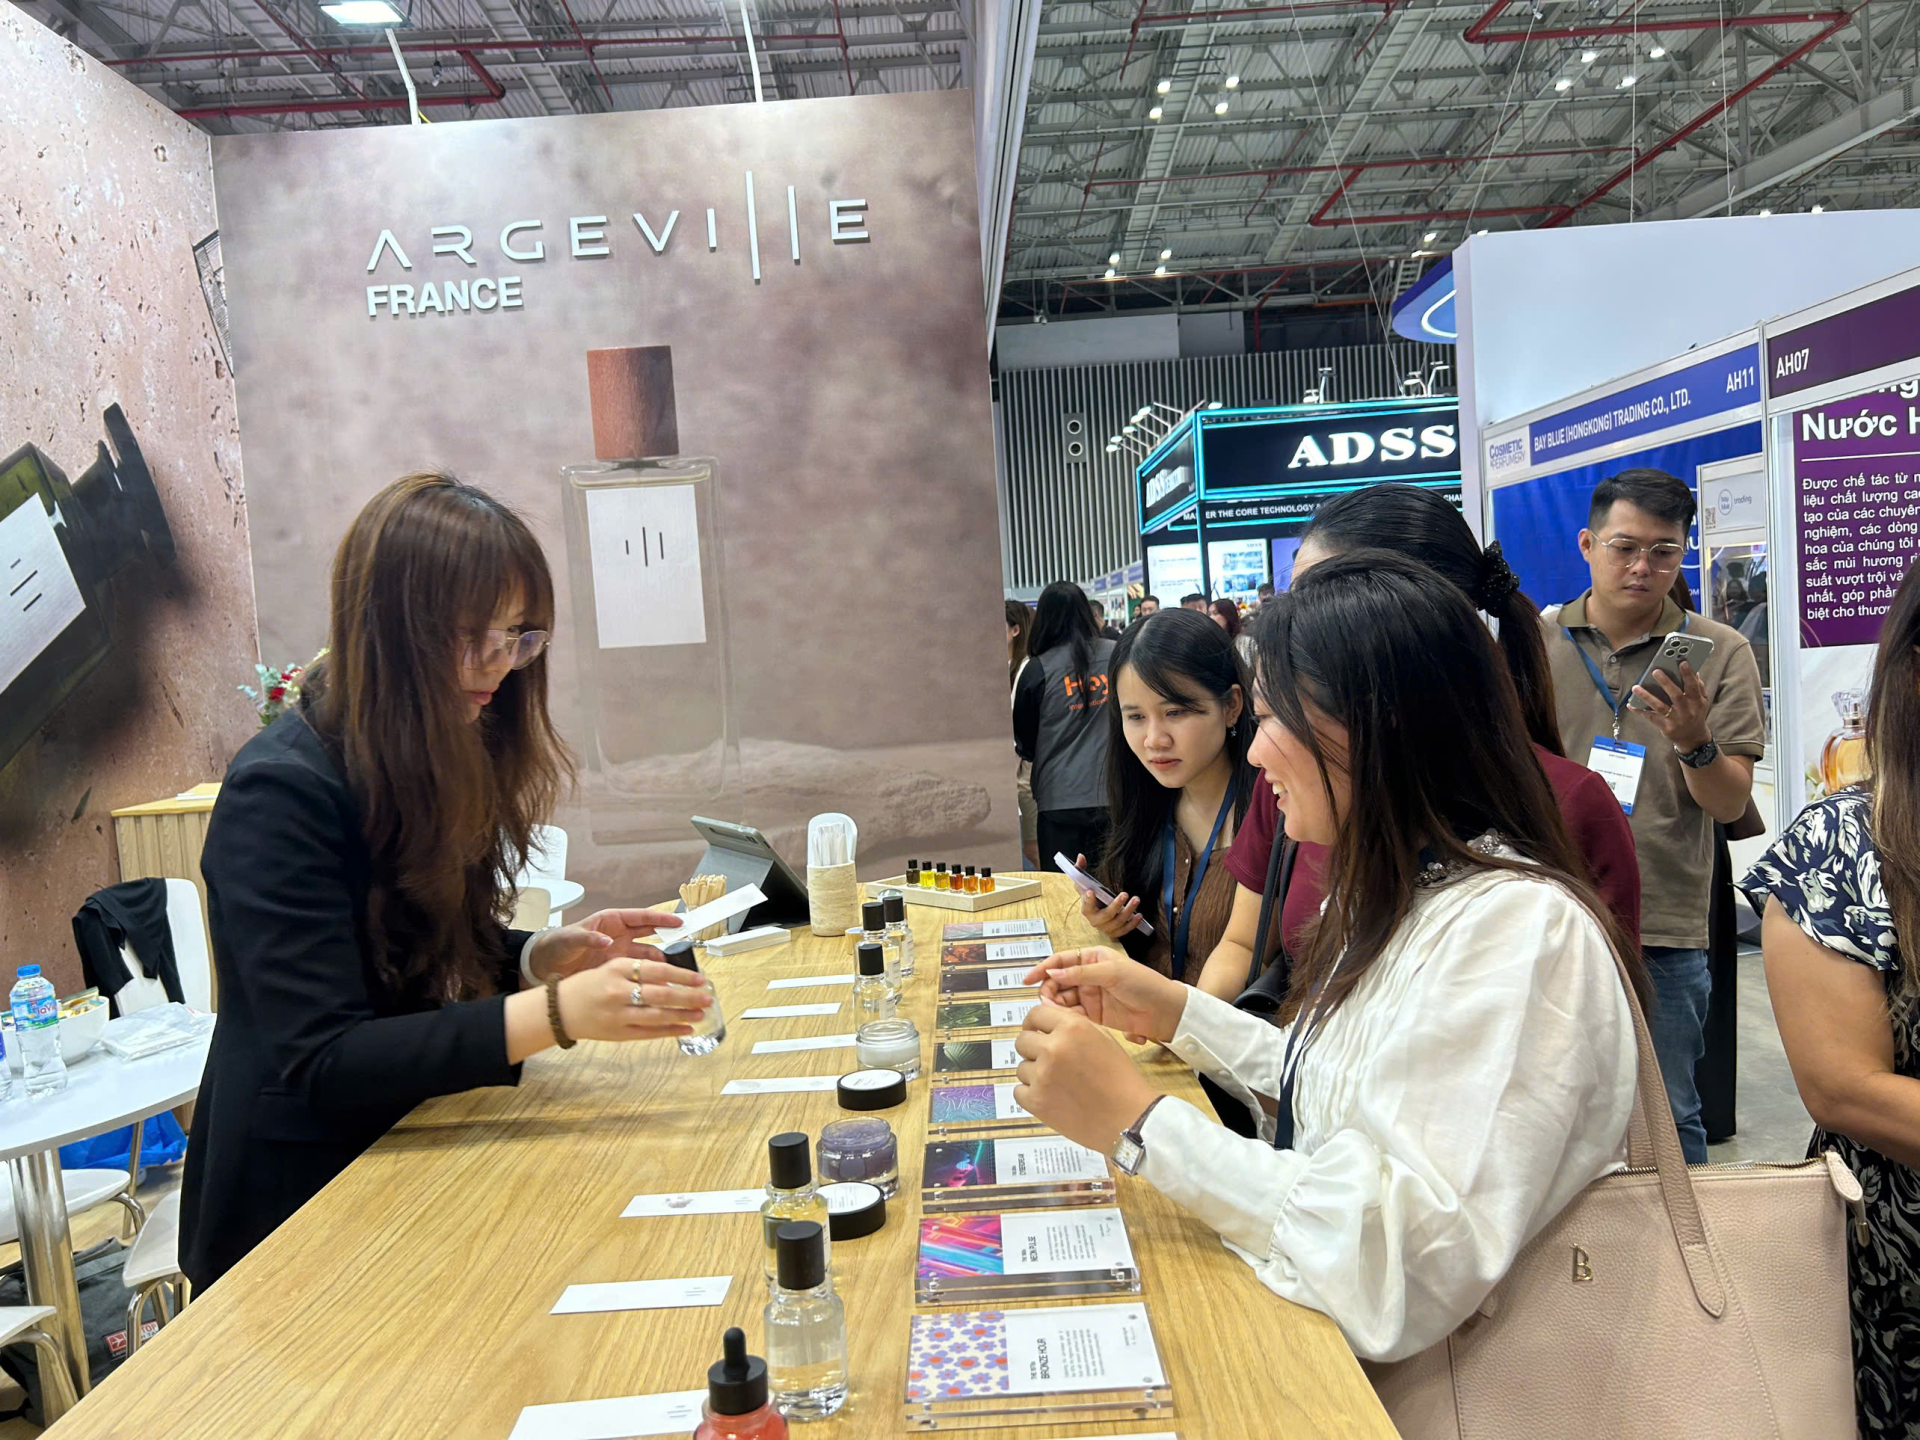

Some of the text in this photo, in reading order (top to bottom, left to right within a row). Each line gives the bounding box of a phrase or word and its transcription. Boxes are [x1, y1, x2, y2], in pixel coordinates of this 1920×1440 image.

[367, 276, 524, 317] FRANCE
[1775, 349, 1810, 379] AH07
[1726, 366, 1754, 393] AH11
[1534, 388, 1691, 452] BAY BLUE (HONGKONG) TRADING CO., LTD.
[1802, 409, 1898, 441] Nước
[1287, 424, 1457, 469] ADSS
[1489, 439, 1523, 459] COSMETIC
[1802, 478, 1838, 491] Được
[1843, 472, 1866, 487] chế
[1870, 473, 1890, 486] tác
[1895, 472, 1909, 485] từ
[1803, 493, 1825, 508] liệu
[1830, 489, 1857, 504] chất
[1862, 491, 1898, 504] lượng
[1218, 509, 1234, 518] THE
[1235, 507, 1258, 516] CORE
[1260, 503, 1314, 515] TECHNOLOGY
[1804, 511, 1823, 524] tạo
[1827, 508, 1849, 521] của
[1853, 507, 1875, 519] các
[1804, 521, 1918, 541] nghiệm, các dòng
[1805, 537, 1914, 555] hoa của chúng tôi
[1805, 557, 1827, 571] sắc
[1834, 557, 1856, 569] mùi
[1863, 556, 1903, 568] hương
[1806, 573, 1832, 588] suất
[1835, 572, 1864, 586] vượt
[1867, 571, 1886, 584] trội
[1806, 589, 1837, 604] nhất,
[1842, 589, 1865, 603] góp
[1807, 607, 1829, 621] biệt
[1832, 606, 1855, 618] cho
[1572, 1243, 1593, 1282] B
